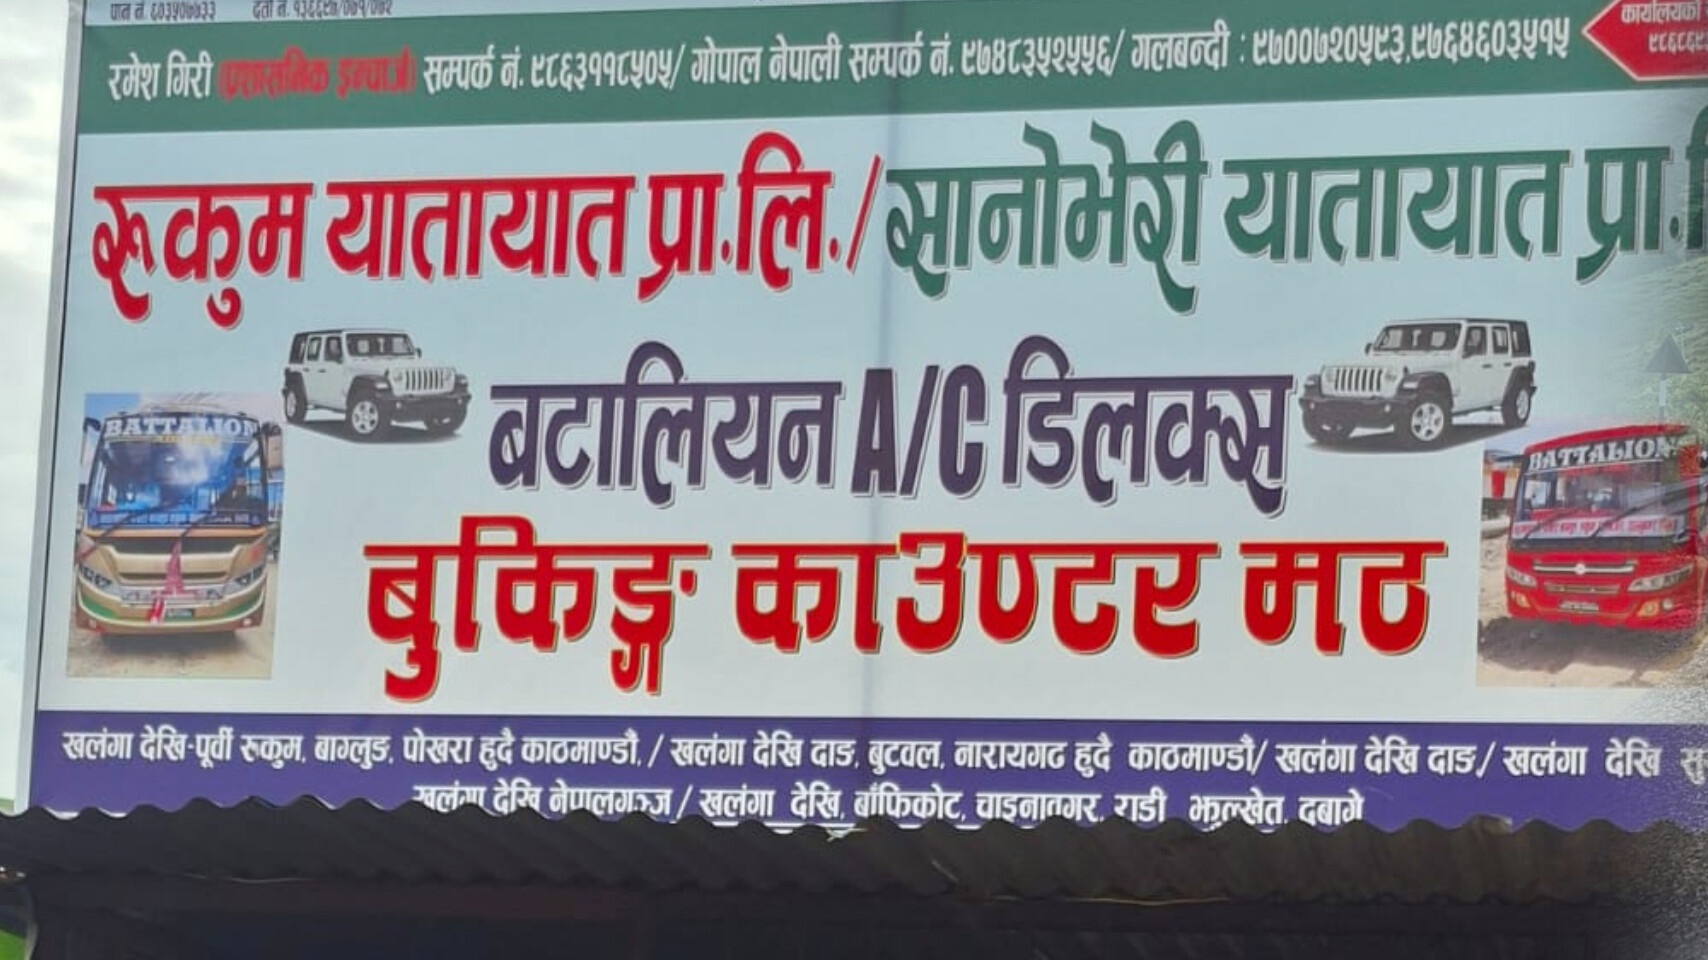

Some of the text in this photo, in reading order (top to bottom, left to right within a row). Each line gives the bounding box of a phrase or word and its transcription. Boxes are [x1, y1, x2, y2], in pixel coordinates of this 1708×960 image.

[108, 53, 160, 100] रमेश
[167, 50, 214, 98] गिरी
[424, 44, 495, 95] सम्पर्क
[501, 45, 524, 90] नं.
[691, 36, 764, 86] गोपाल
[769, 32, 843, 83] नेपाली
[849, 30, 925, 82] सम्पर्क
[930, 32, 954, 77] नं.
[1132, 18, 1231, 71] गलबन्दी
[327, 174, 637, 283] यातायात
[885, 121, 1209, 317] सानोभेरी
[1223, 151, 1572, 270] यातायात
[104, 417, 258, 437] BATTALION
[490, 333, 1297, 519] बटालियन A/C डिलक्स
[732, 531, 1221, 660] काउण्टर
[1239, 540, 1451, 658] मठ
[62, 726, 133, 762] खलंगा
[403, 726, 473, 765] पोखरा
[478, 727, 514, 771] हुदै
[671, 731, 746, 768] खलंगा
[753, 730, 803, 769] देखि
[1074, 731, 1114, 779] हुदै
[1275, 738, 1358, 774] खलंगा
[1364, 735, 1420, 775] देखि
[1502, 738, 1588, 776] खलंगा
[1606, 737, 1662, 778] देखि
[699, 783, 776, 818] खलंगा
